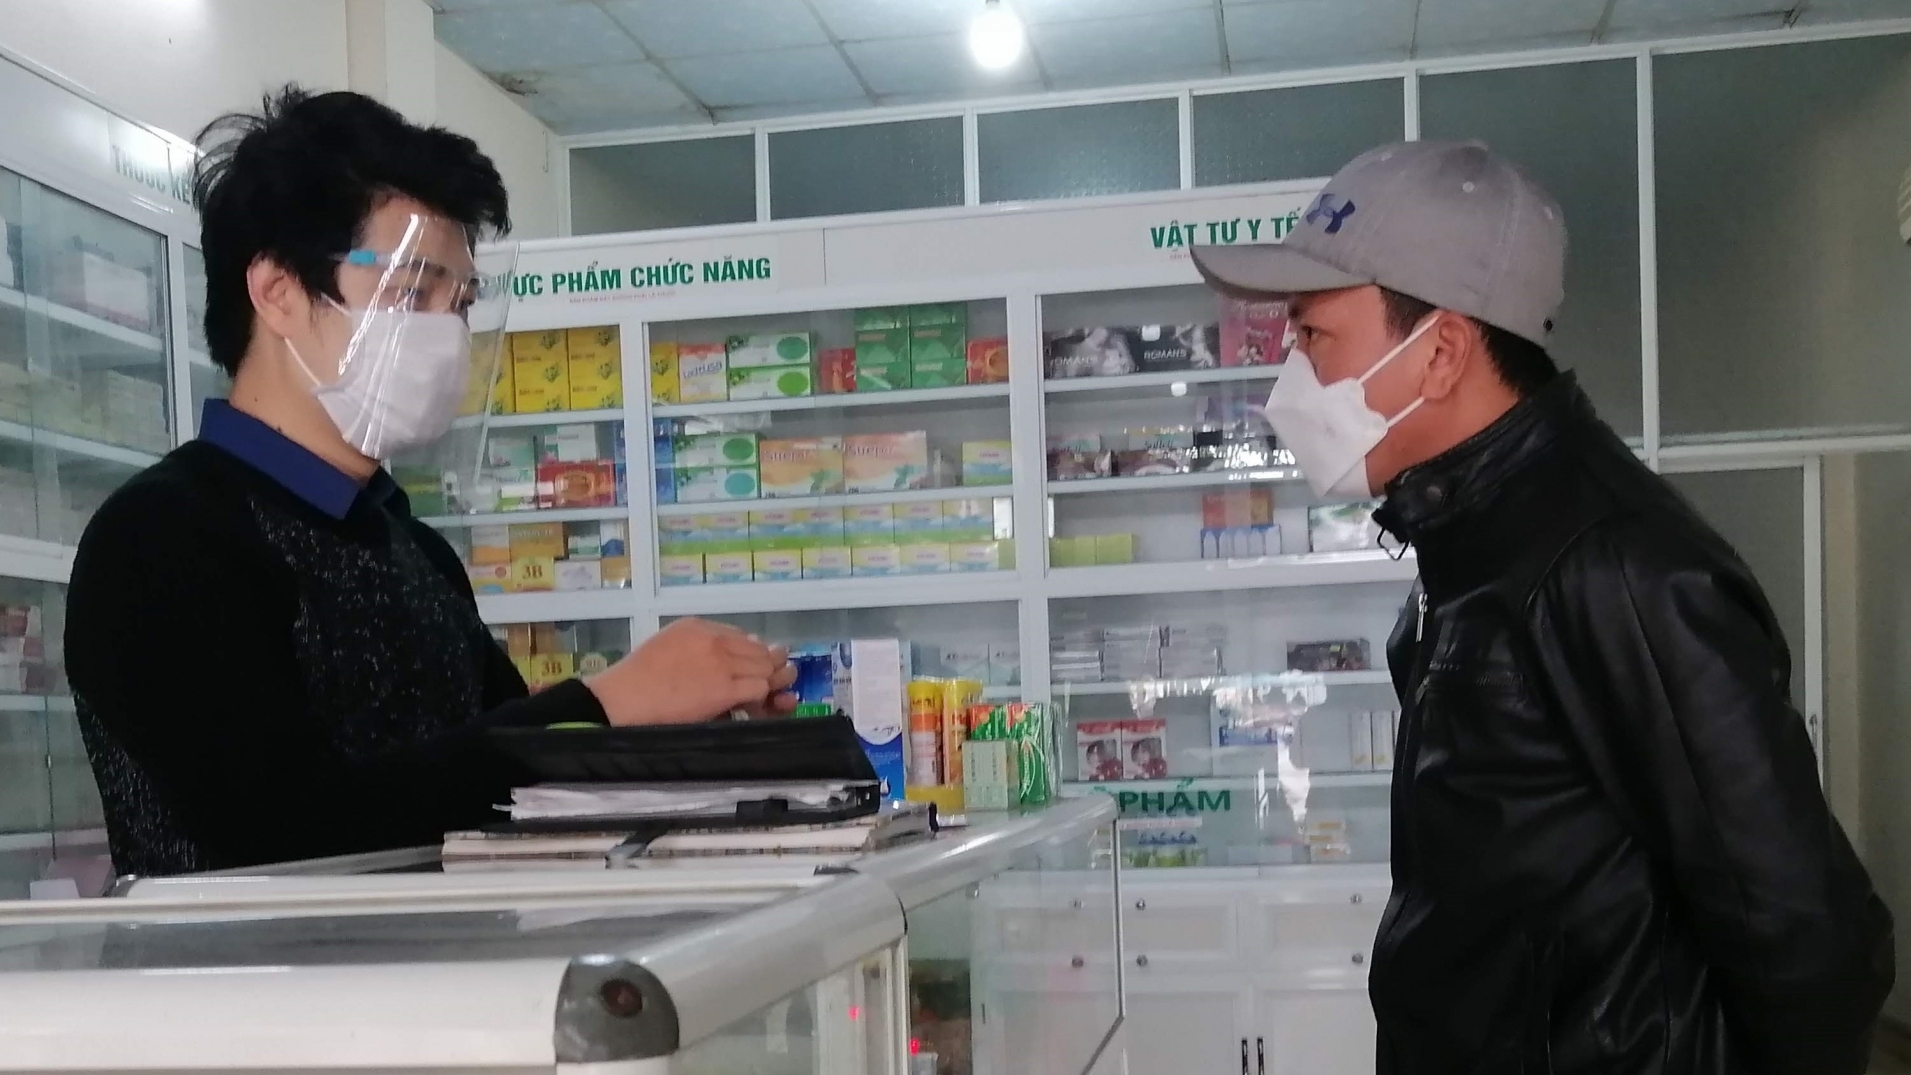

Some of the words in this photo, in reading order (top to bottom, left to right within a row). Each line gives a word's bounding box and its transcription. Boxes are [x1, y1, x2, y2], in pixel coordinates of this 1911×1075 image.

[1150, 219, 1198, 251] VẬT
[1206, 218, 1241, 245] TƯ
[1247, 217, 1262, 241] Y
[552, 260, 622, 293] PHẨM
[630, 258, 694, 288] CHỨC
[702, 254, 771, 282] NĂNG
[522, 565, 543, 579] 3B
[541, 661, 563, 677] 3B
[1118, 777, 1231, 814] PHẨM
